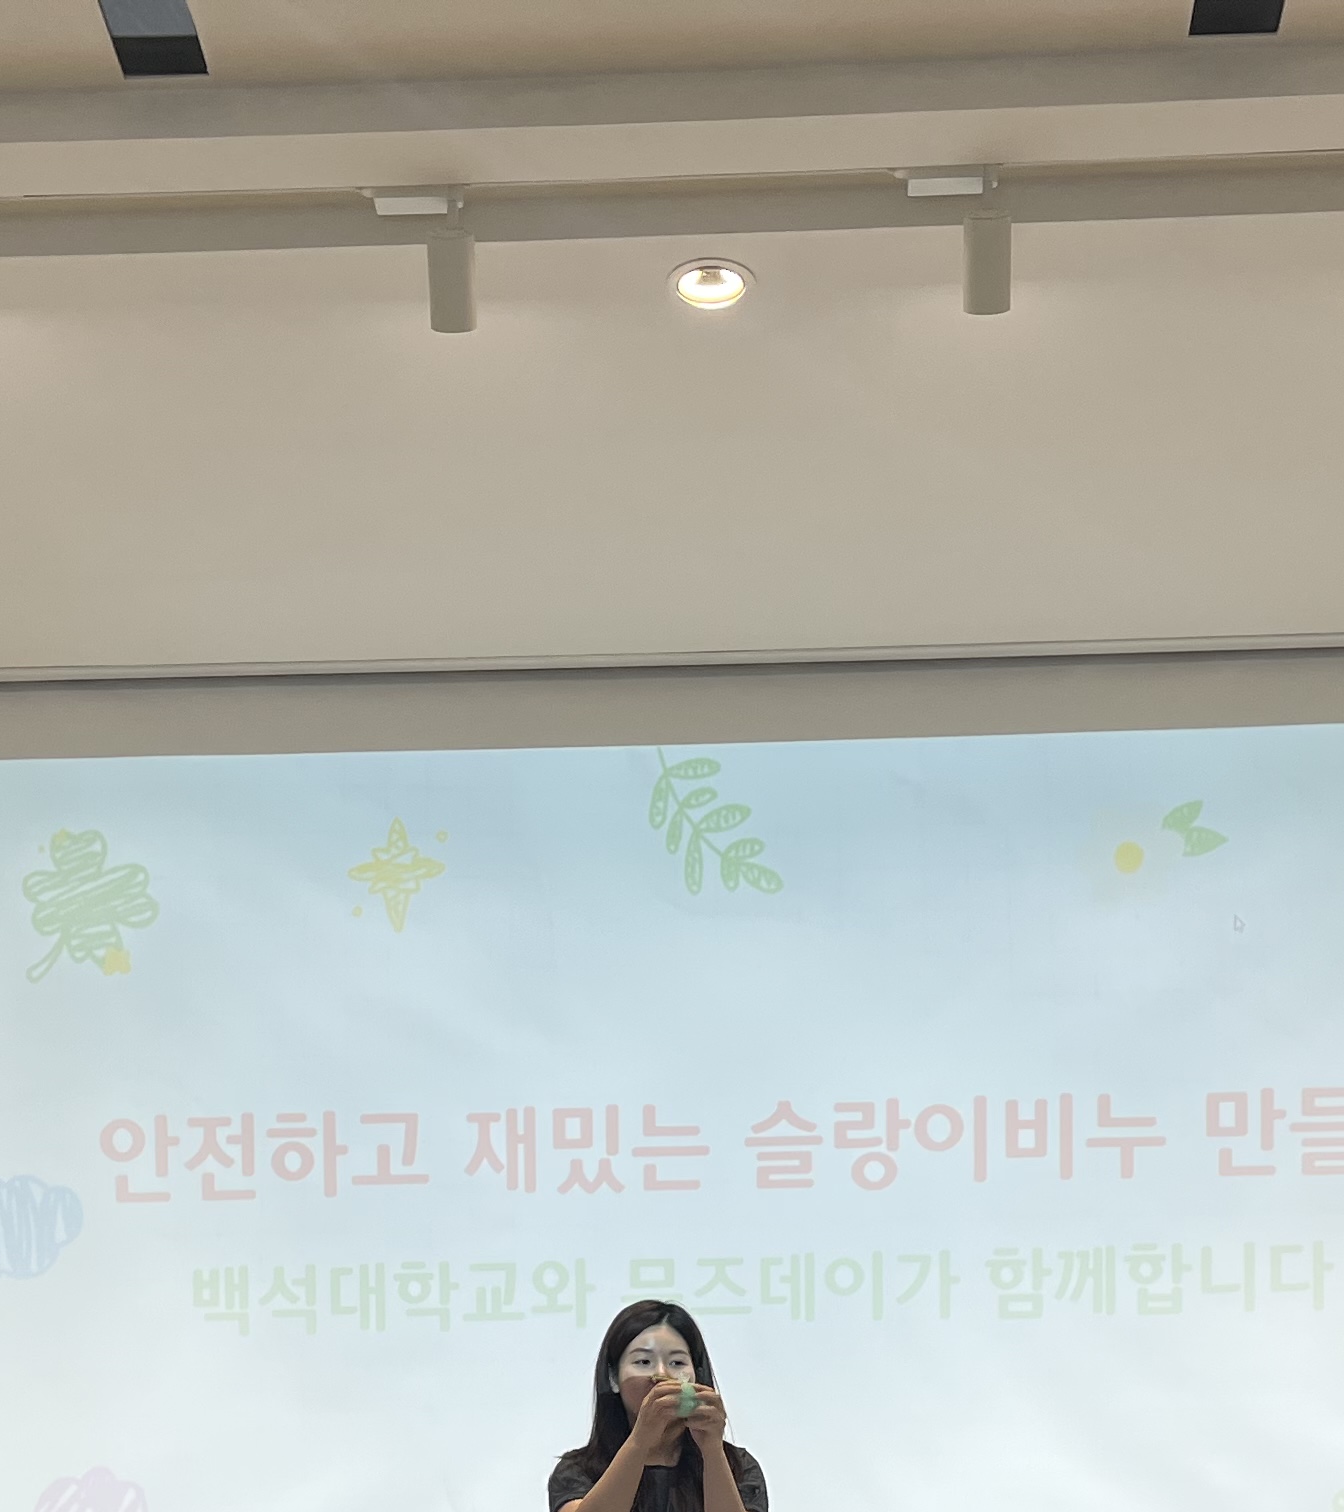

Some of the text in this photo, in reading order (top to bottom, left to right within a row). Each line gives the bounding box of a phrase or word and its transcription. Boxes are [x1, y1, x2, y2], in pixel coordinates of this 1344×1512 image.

[99, 1109, 430, 1204] 안전하고
[463, 1103, 711, 1195] 재밌는
[744, 1091, 1167, 1191] 슬랑이비누
[191, 1256, 596, 1337] 백석대학교와
[984, 1239, 1335, 1321] 함께합니다
